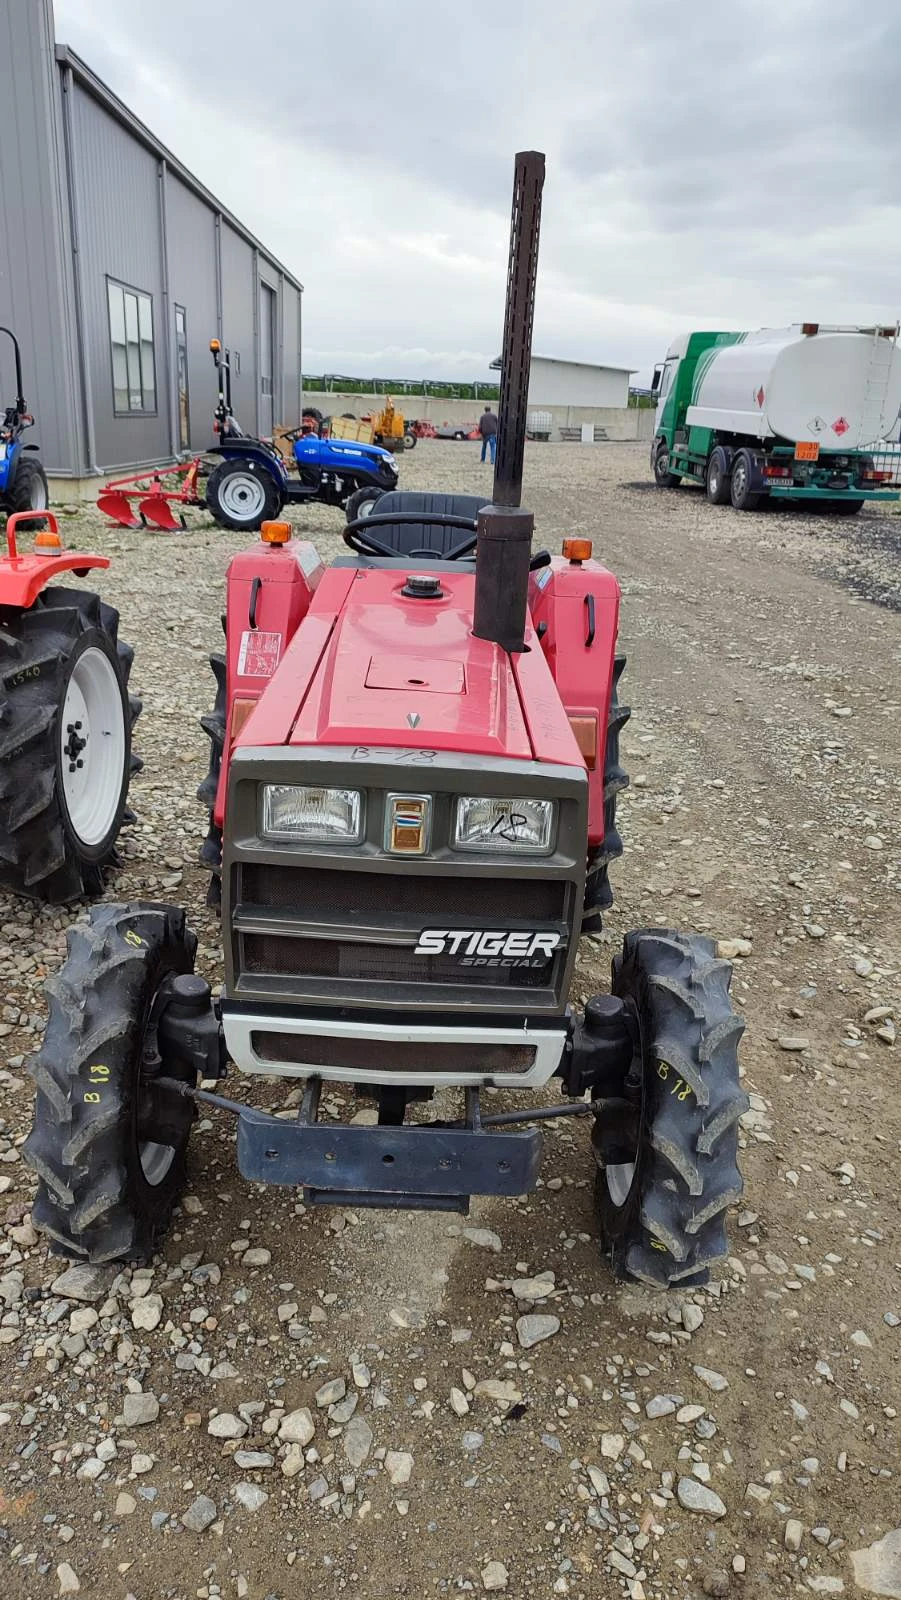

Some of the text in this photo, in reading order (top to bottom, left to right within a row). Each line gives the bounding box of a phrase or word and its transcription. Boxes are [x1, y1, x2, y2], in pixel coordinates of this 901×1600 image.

[490, 813, 528, 842] 18
[414, 930, 561, 958] STIGER
[460, 957, 546, 968] SPECIAL
[84, 1065, 110, 1103] B 18
[657, 1061, 692, 1101] B 18
